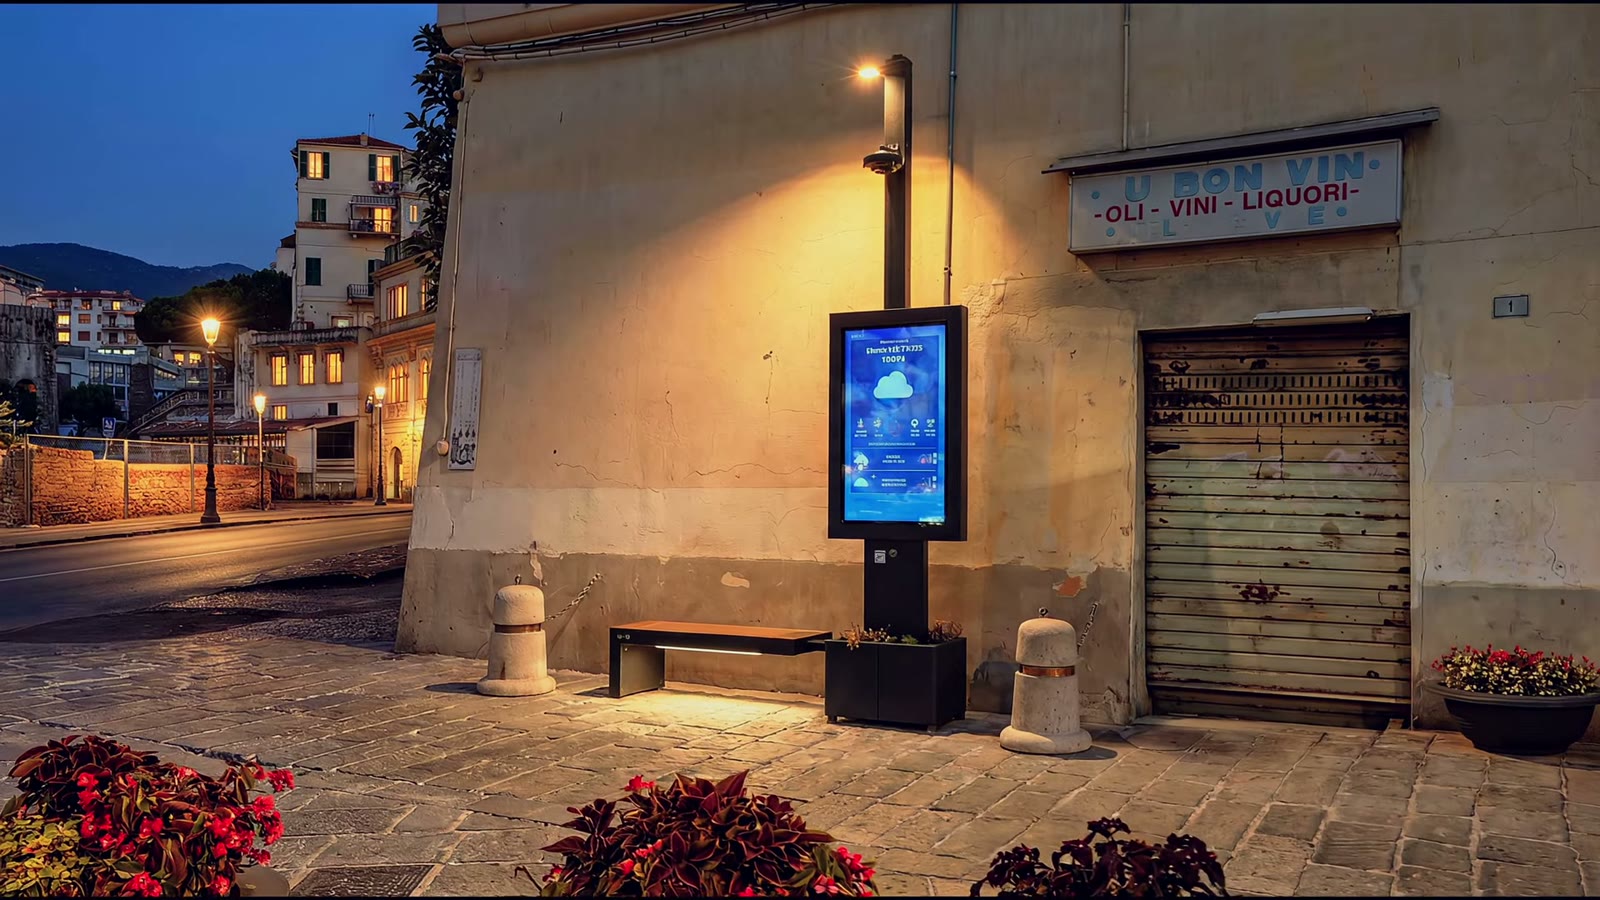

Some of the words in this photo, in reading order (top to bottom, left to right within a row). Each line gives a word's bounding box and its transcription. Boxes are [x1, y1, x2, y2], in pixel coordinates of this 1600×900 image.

[1125, 176, 1151, 202] U
[1174, 163, 1263, 199] BON
[1286, 152, 1364, 186] VIN
[1169, 196, 1217, 217] VINI
[1508, 299, 1513, 313] 1
